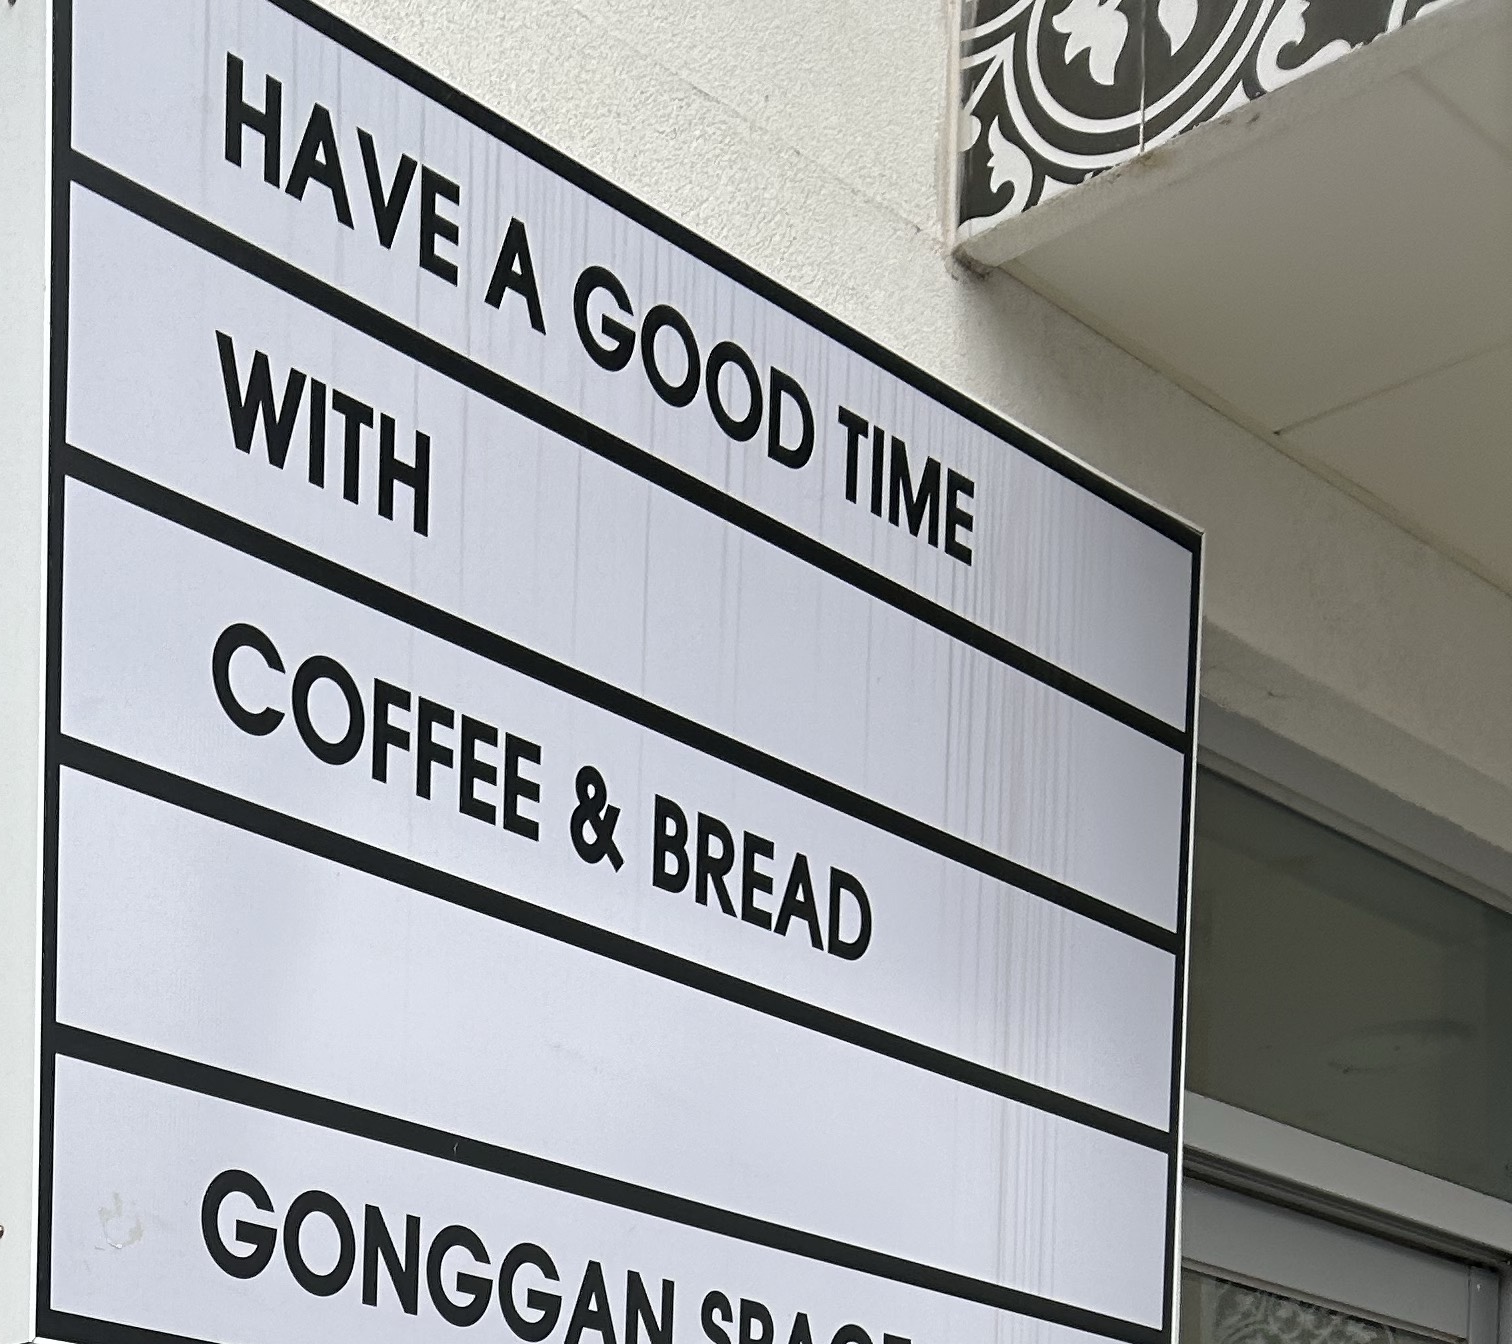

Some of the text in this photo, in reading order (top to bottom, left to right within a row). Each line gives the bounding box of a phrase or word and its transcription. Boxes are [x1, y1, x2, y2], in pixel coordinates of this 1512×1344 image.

[215, 330, 431, 538] WITH
[225, 52, 975, 567] HAVE A GOOD TIME
[212, 622, 872, 961] COFFEE & BREAD
